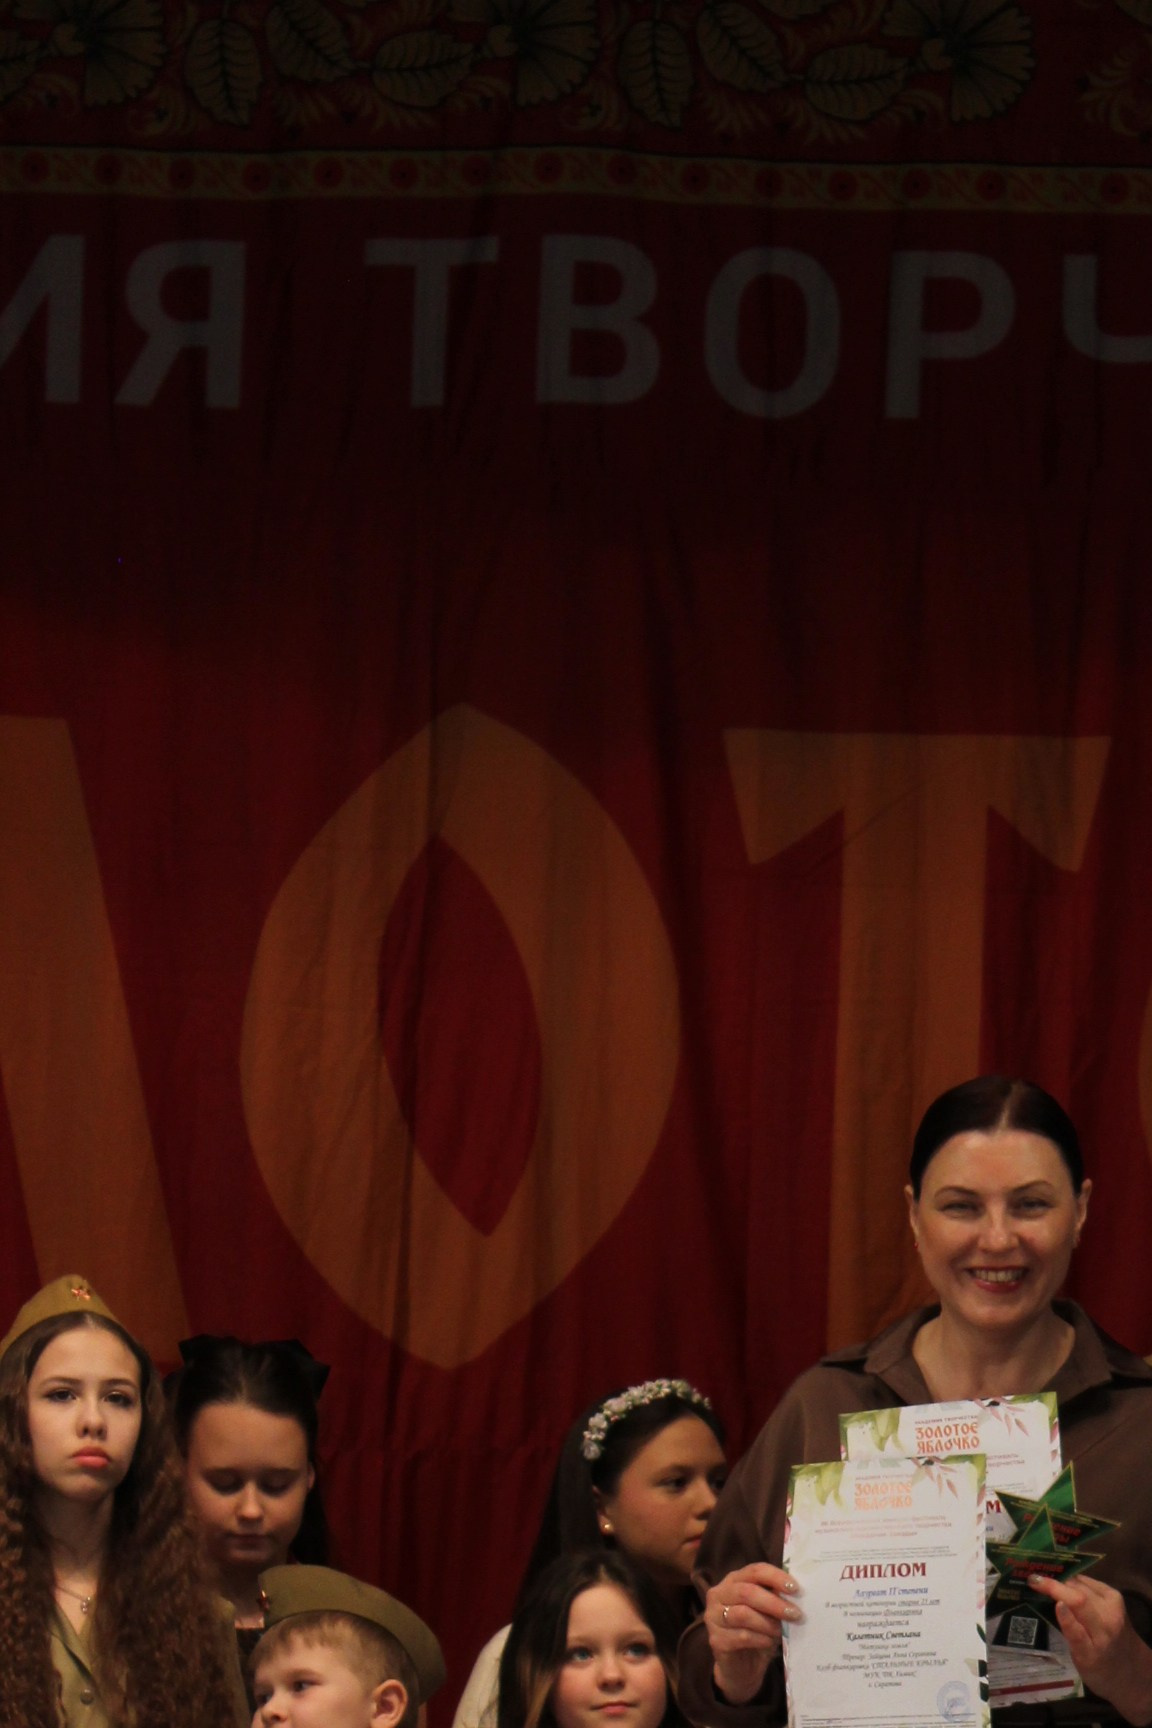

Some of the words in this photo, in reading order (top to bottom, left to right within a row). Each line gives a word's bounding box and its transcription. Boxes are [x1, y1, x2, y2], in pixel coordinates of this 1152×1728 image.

[915, 1421, 979, 1440] ЗОЛОТОЕ
[917, 1436, 980, 1455] ЯБЛОЧКО
[839, 1562, 927, 1582] ДИПЛОМ
